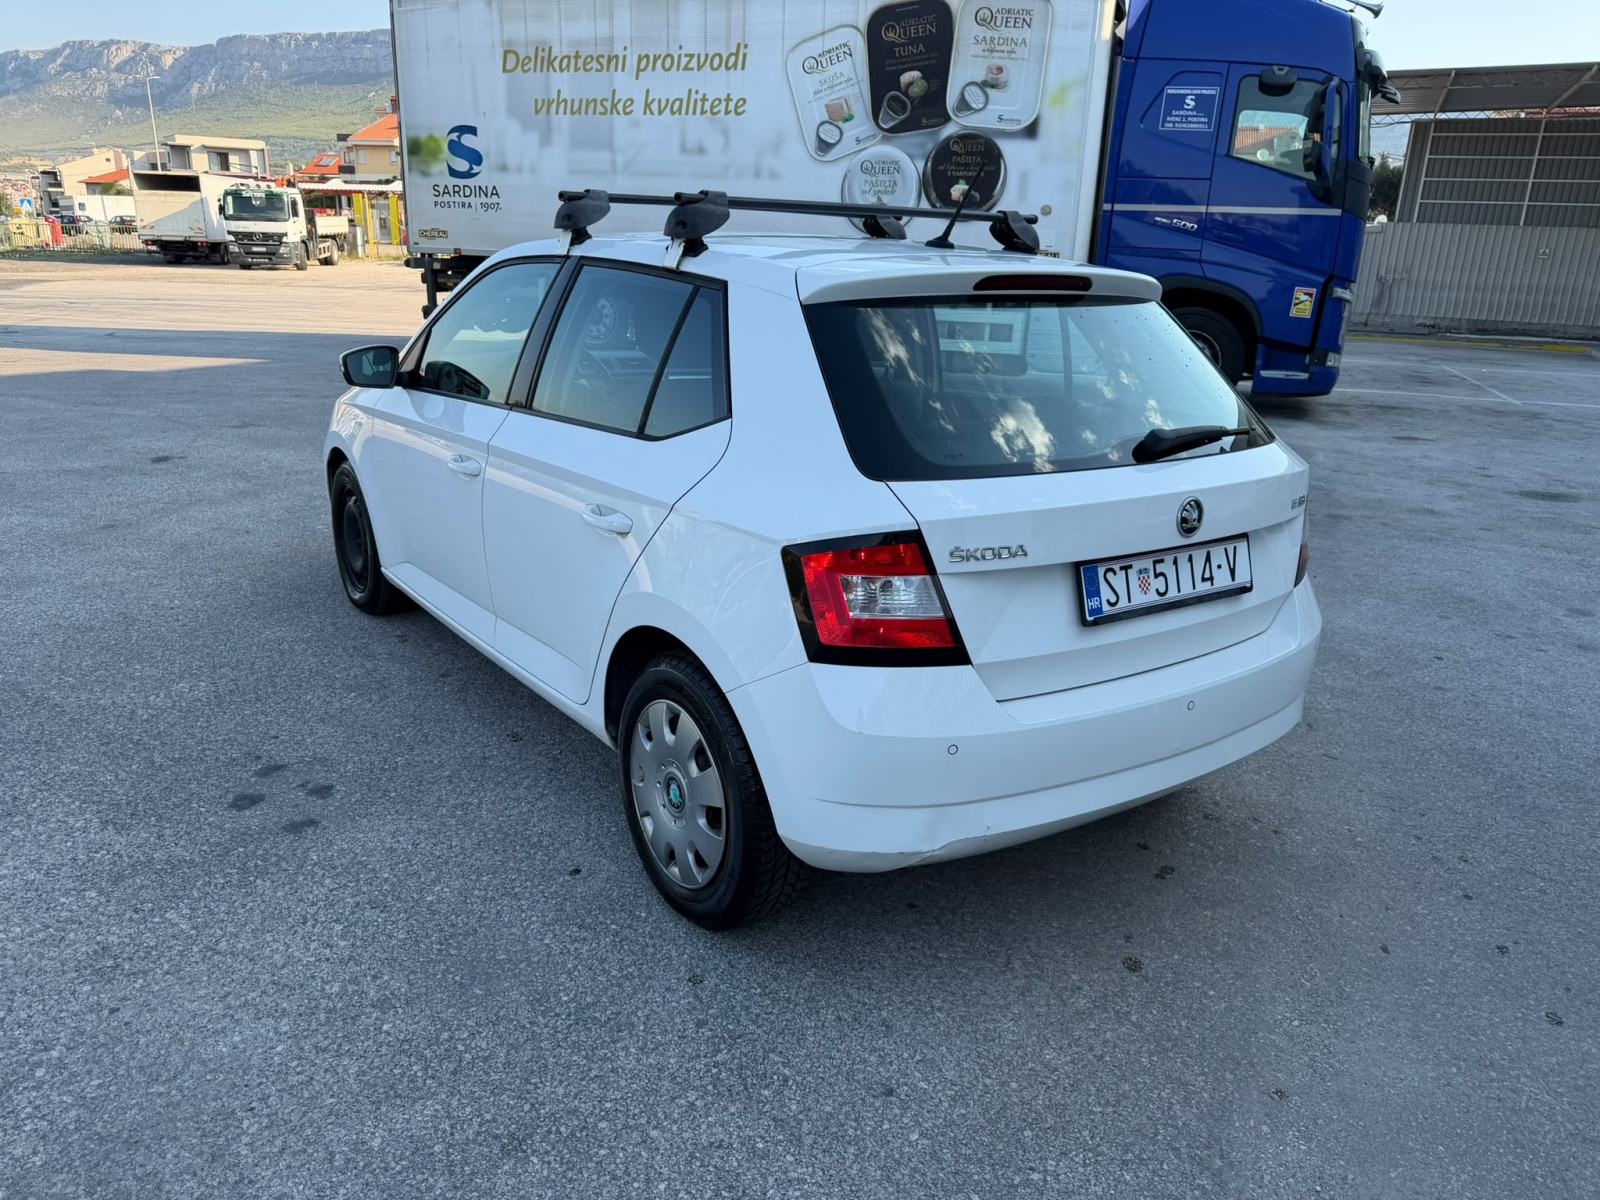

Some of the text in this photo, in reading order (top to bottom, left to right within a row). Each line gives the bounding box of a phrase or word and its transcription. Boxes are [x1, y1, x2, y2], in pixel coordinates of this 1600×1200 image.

[900, 14, 937, 27] ADRIATIC
[974, 6, 1033, 31] QUEEN
[995, 8, 1035, 16] ADRIATIC
[881, 22, 937, 43] QUEEN
[972, 34, 1028, 48] SARDINA
[817, 40, 850, 58] ADRIATIC
[893, 43, 926, 57] TUNA
[502, 42, 749, 81] Delikatesni proizvodi
[802, 47, 853, 75] QUEEN
[534, 88, 748, 116] vrhunske kvalitete
[950, 138, 985, 154] QUEEN
[860, 159, 901, 178] QUEEN
[432, 184, 501, 198] SARDINA
[434, 200, 502, 212] POSTIRA 1907.
[1171, 219, 1198, 231] 500
[949, 544, 1029, 563] ŠKODA
[1103, 545, 1237, 608] ST 5114-V
[1088, 596, 1101, 610] HR
